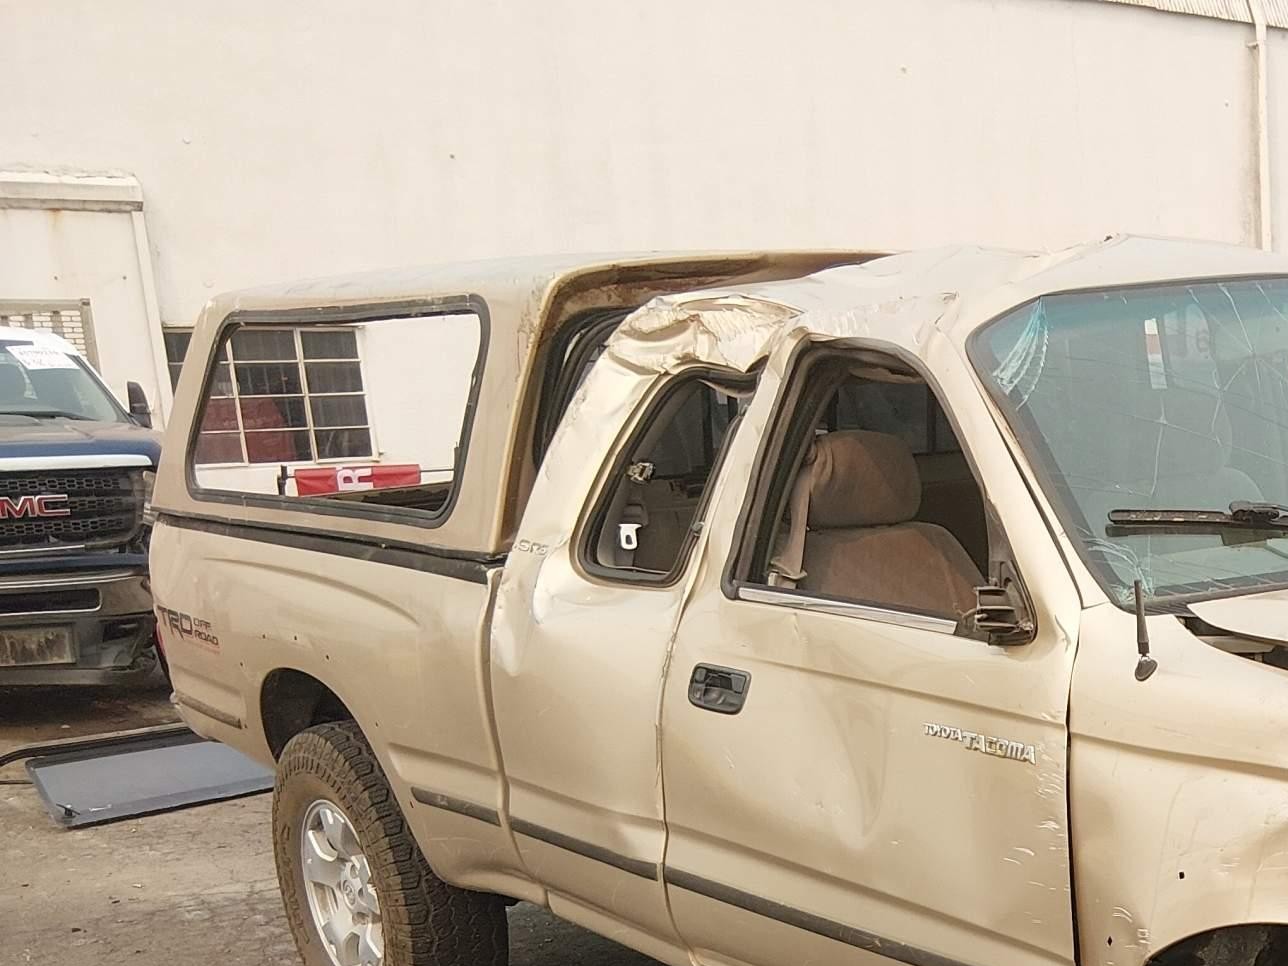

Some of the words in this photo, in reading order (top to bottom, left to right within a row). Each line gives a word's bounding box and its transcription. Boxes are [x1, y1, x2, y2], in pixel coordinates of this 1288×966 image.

[157, 605, 193, 640] TRD
[194, 629, 219, 646] ROAD
[962, 731, 1036, 765] TACOMA
